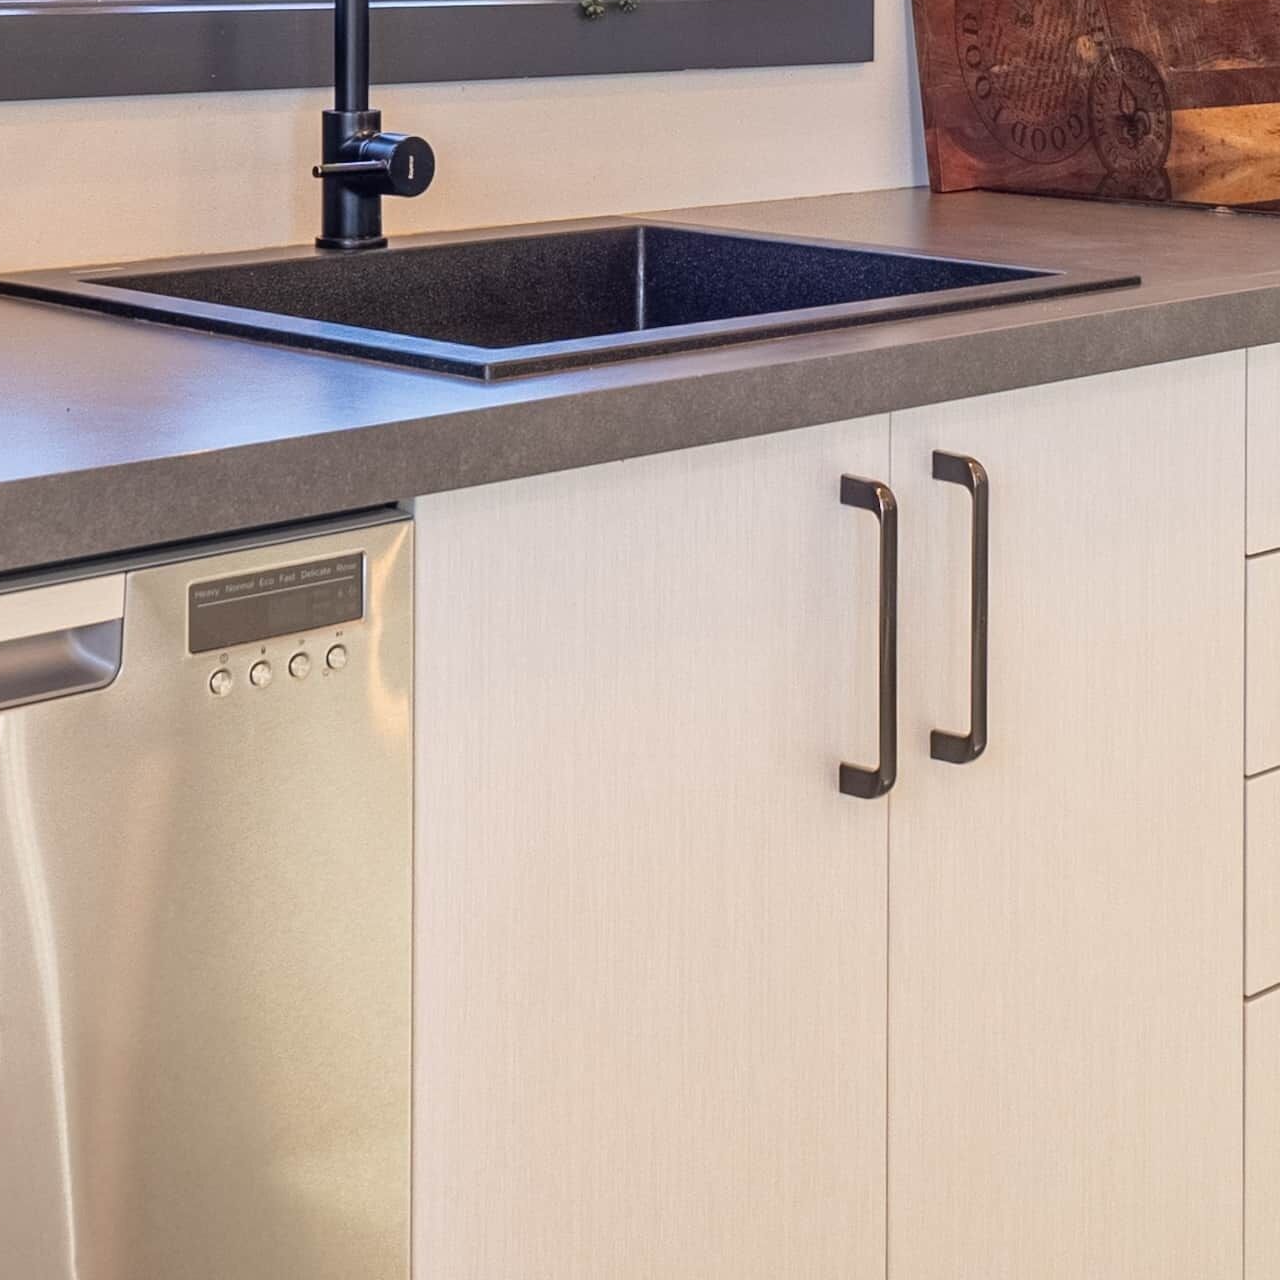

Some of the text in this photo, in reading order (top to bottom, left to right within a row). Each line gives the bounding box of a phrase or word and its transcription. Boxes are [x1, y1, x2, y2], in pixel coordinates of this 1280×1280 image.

[225, 580, 255, 593] Normal
[259, 576, 275, 587] Eco
[279, 572, 296, 584] Fast
